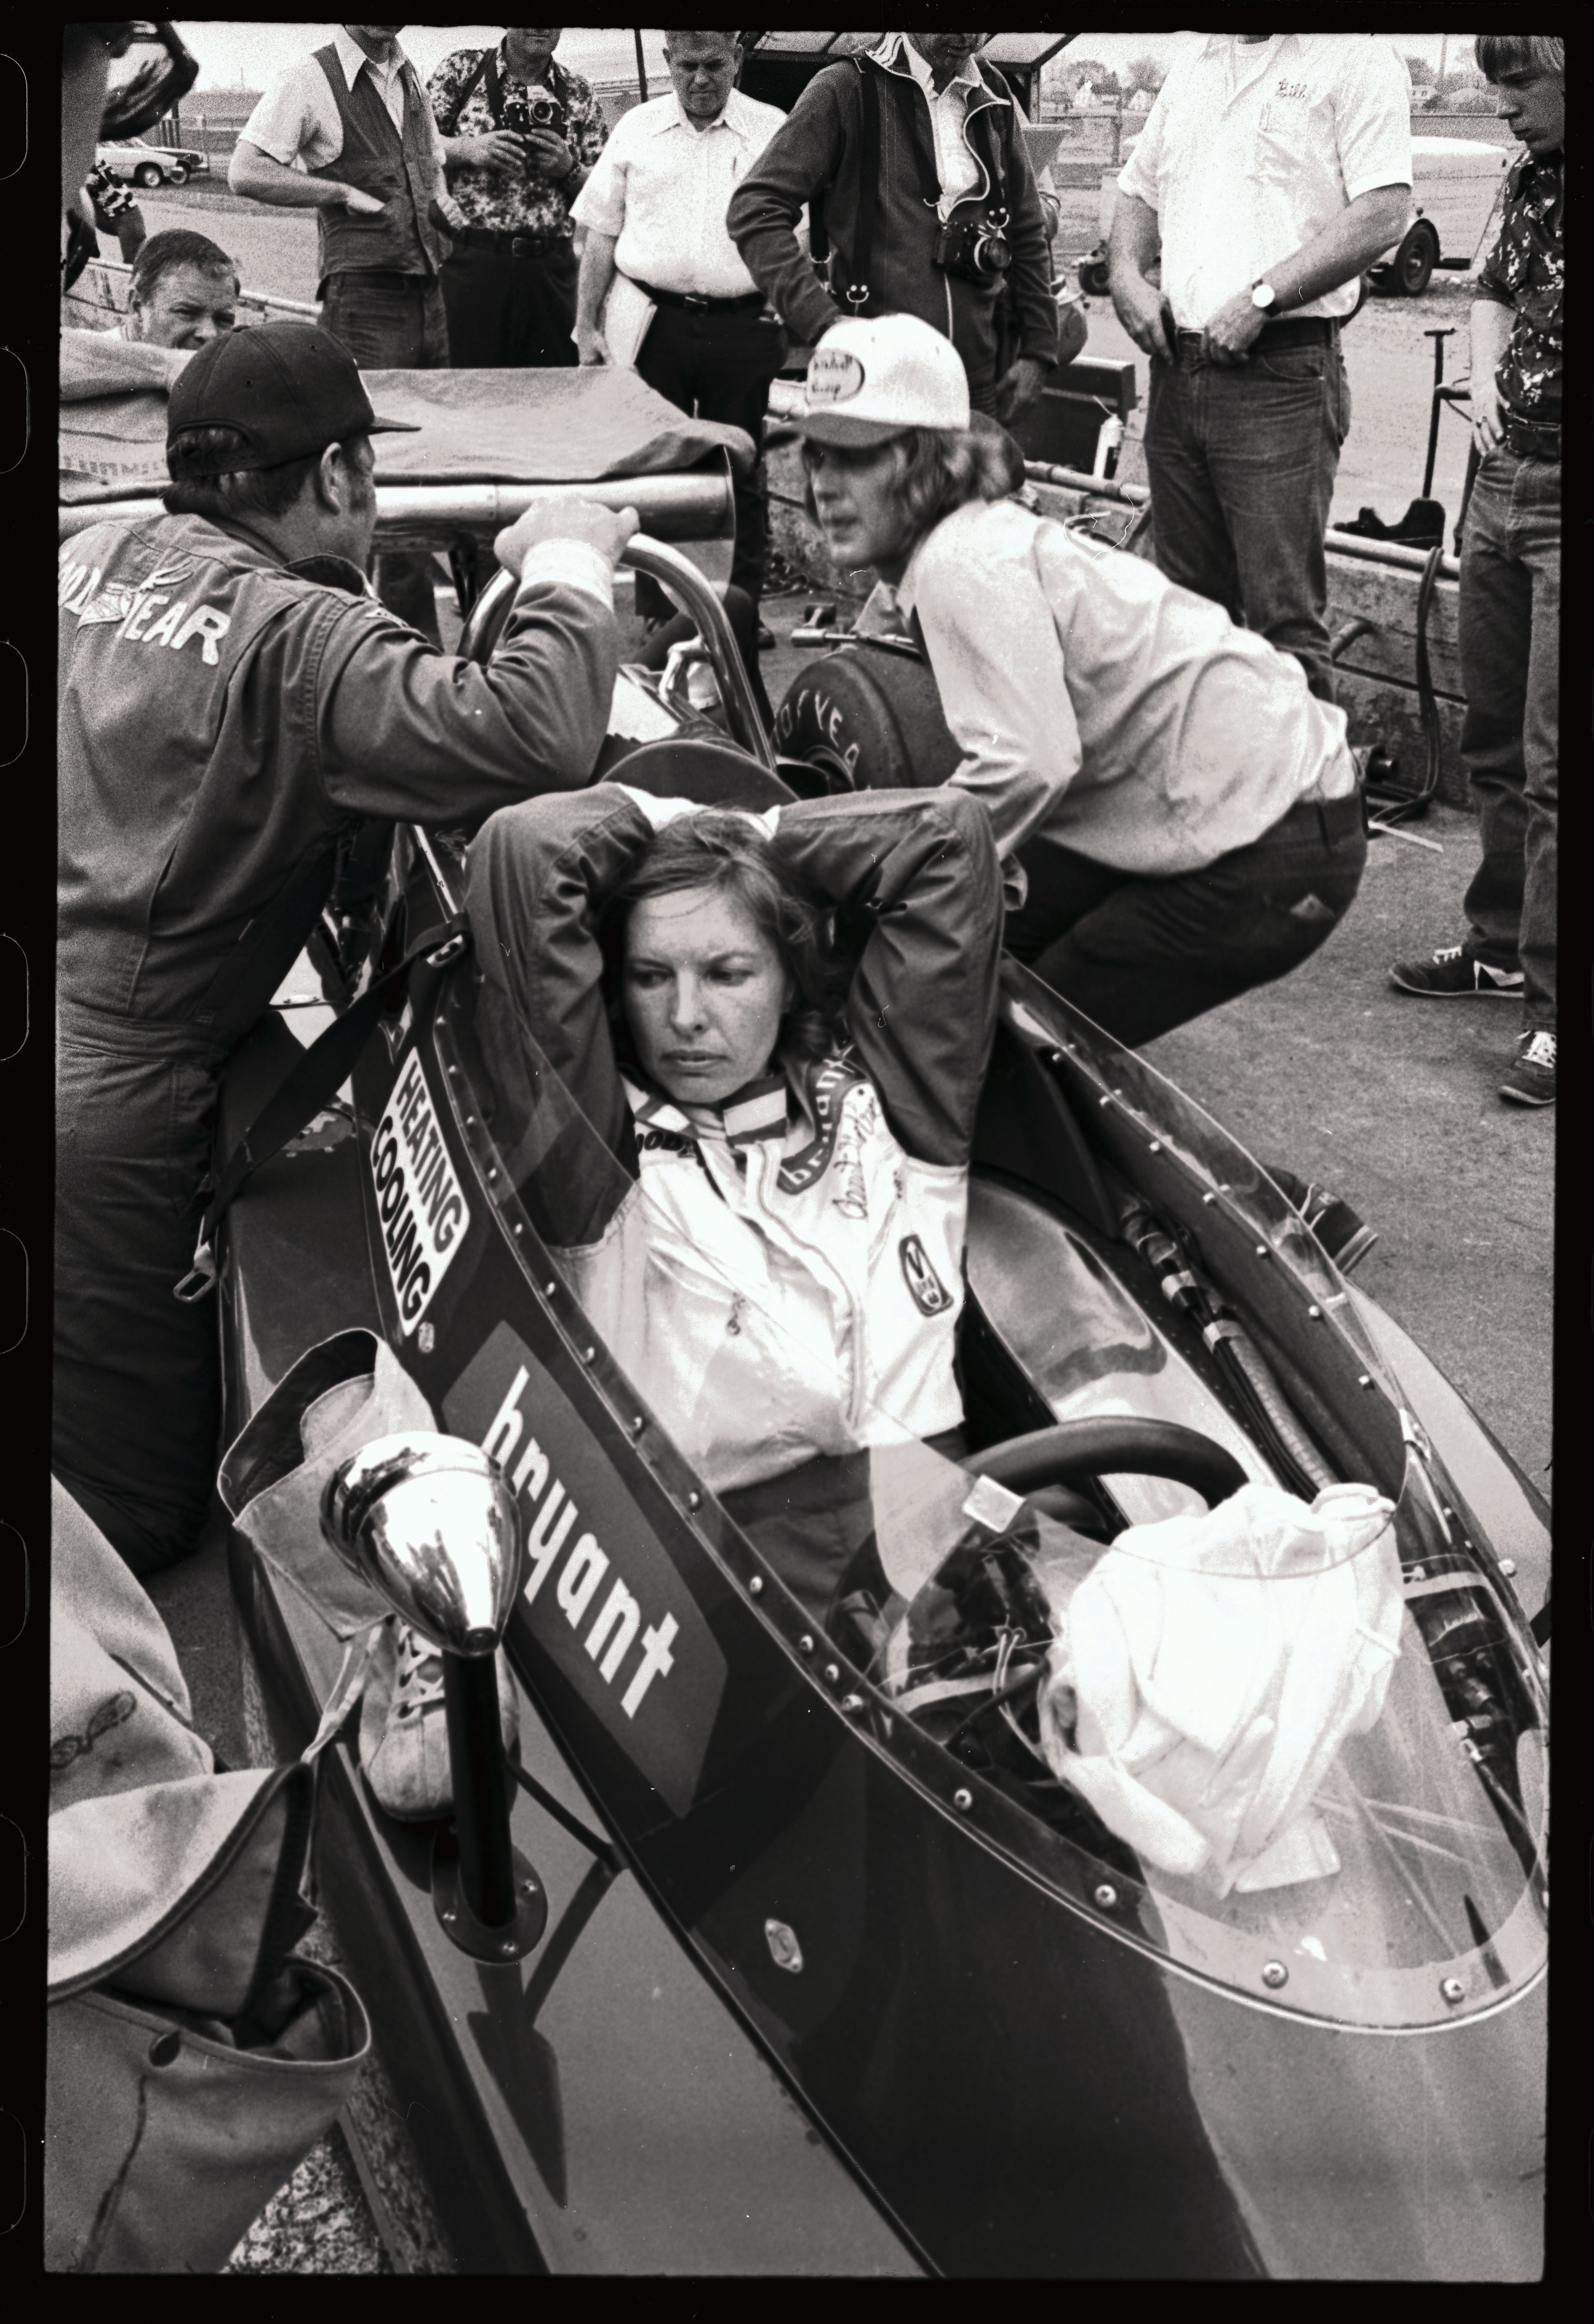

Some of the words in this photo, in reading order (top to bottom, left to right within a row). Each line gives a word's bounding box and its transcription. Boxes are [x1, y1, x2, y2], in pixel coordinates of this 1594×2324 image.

[1274, 78, 1307, 98] Bill
[372, 1115, 431, 1321] COOLING
[396, 1060, 462, 1253] HEATING
[481, 1364, 680, 1720] bryant
